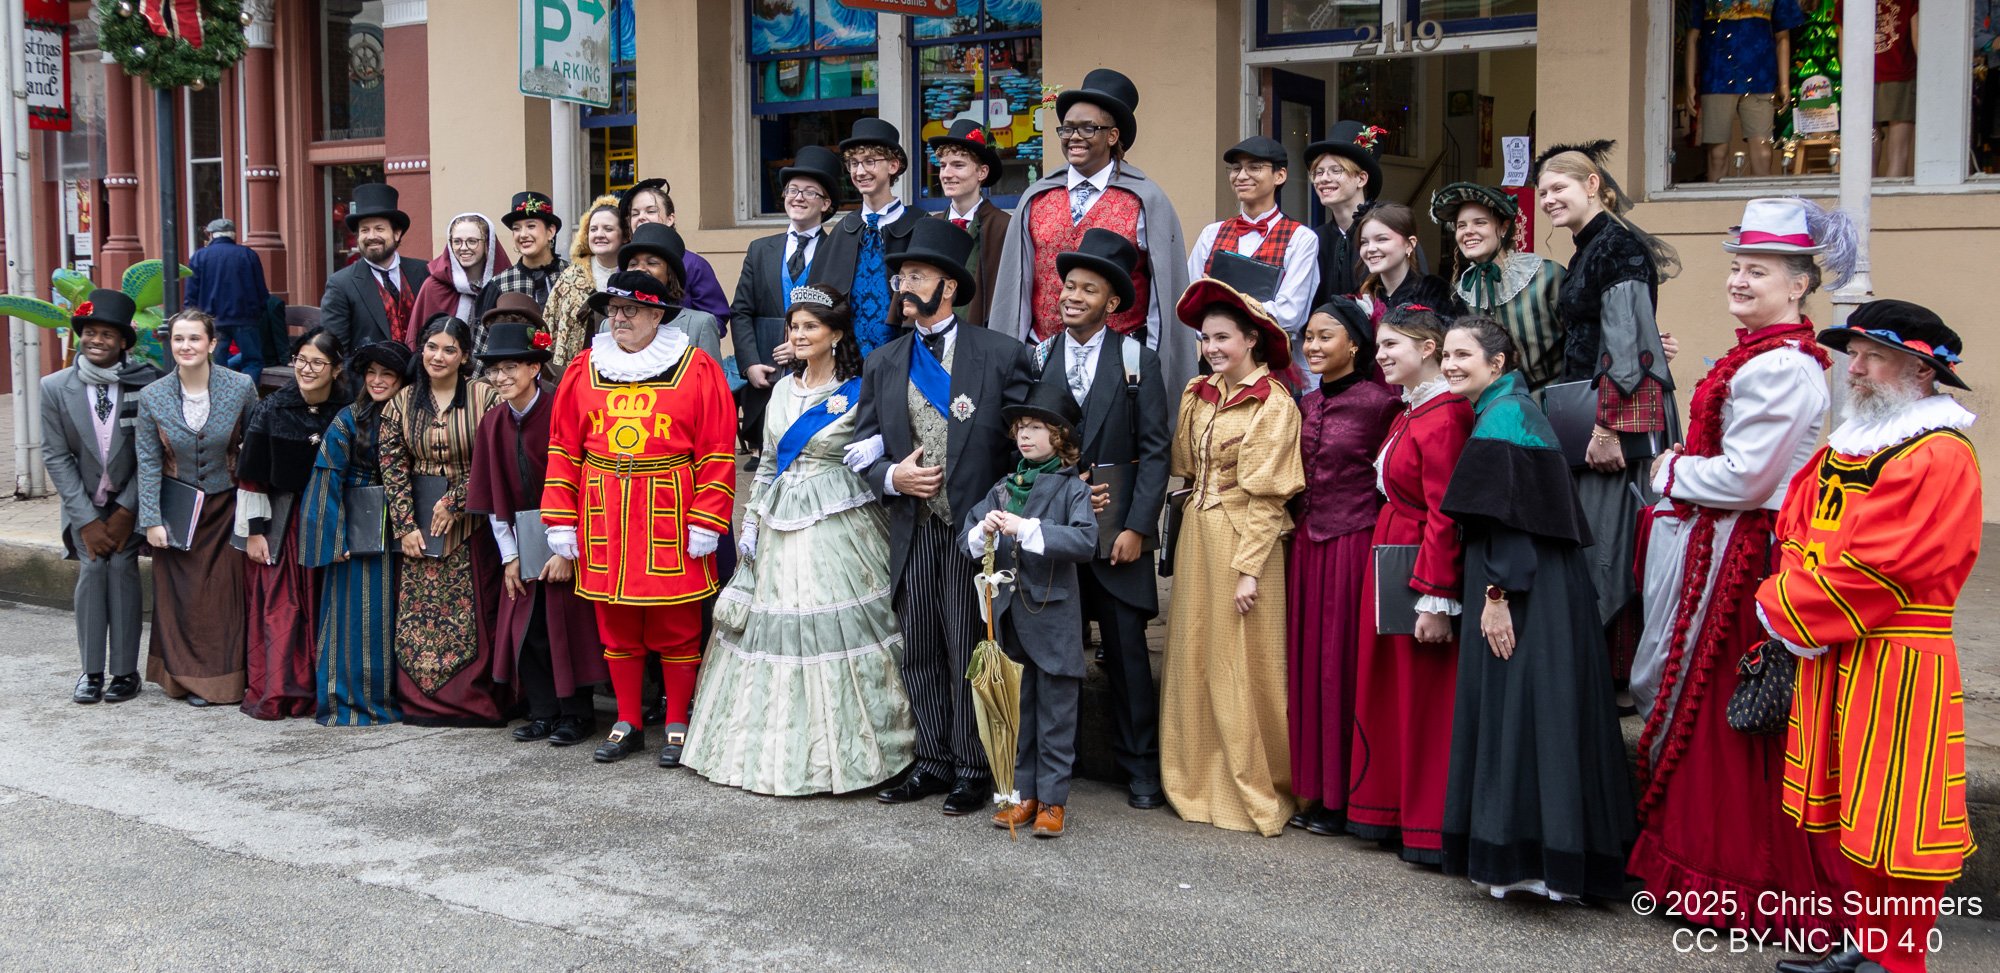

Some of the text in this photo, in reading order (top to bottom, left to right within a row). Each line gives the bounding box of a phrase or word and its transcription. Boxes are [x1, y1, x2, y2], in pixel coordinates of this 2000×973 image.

[25, 36, 61, 57] stmas
[1353, 20, 1443, 56] 2119
[25, 56, 60, 75] n the
[26, 76, 59, 96] and
